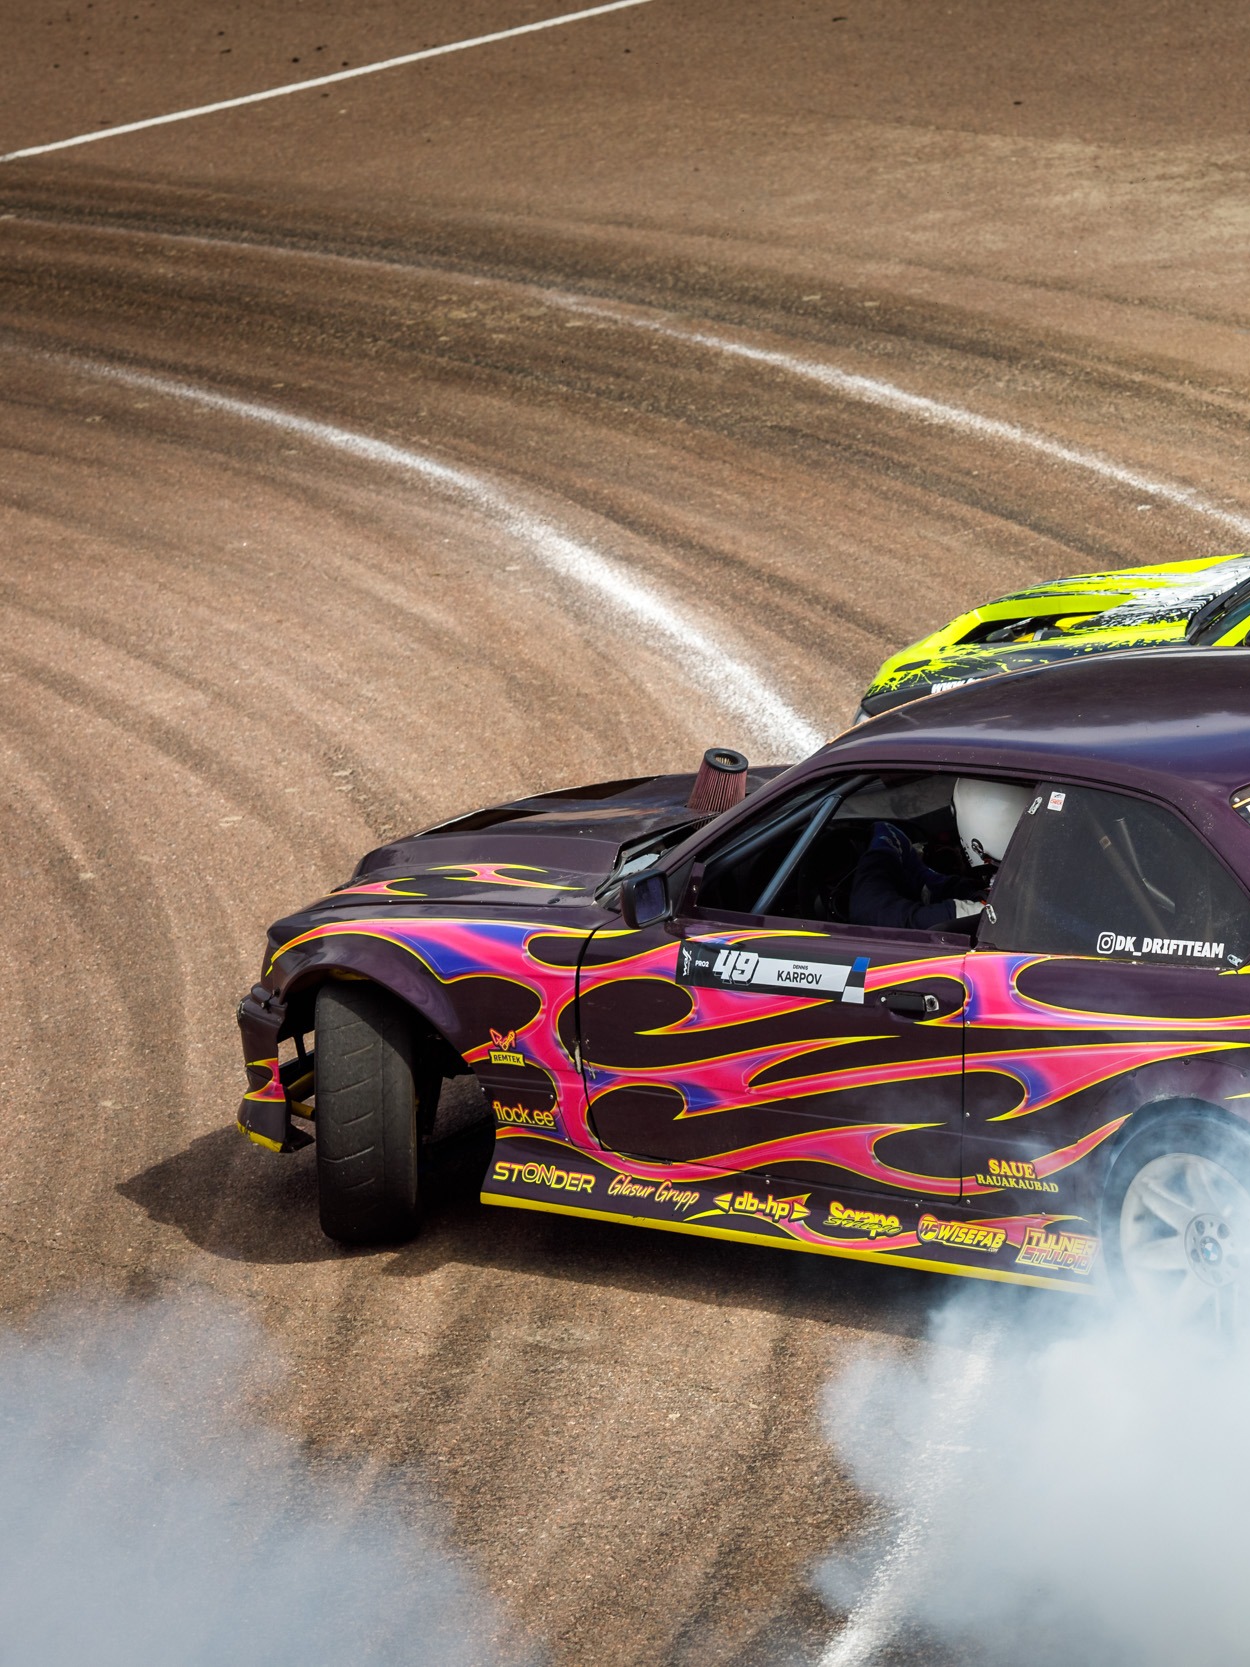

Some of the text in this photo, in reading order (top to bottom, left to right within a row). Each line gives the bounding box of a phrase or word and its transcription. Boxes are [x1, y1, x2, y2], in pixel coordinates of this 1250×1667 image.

[1115, 935, 1225, 958] DK_DRIFTTEAM
[695, 960, 710, 968] PRO2
[712, 949, 760, 986] 49
[776, 970, 822, 985] KARPOV
[494, 1054, 521, 1064] REMTEK
[493, 1101, 555, 1127] flock.ee
[493, 1162, 596, 1193] STONDER
[988, 1159, 1036, 1179] SAUE
[607, 1174, 700, 1211] Glasur Grupp
[976, 1174, 1059, 1193] RAUAKAUBAD
[734, 1191, 790, 1222] db-hp
[937, 1224, 1007, 1248] WISEFAB
